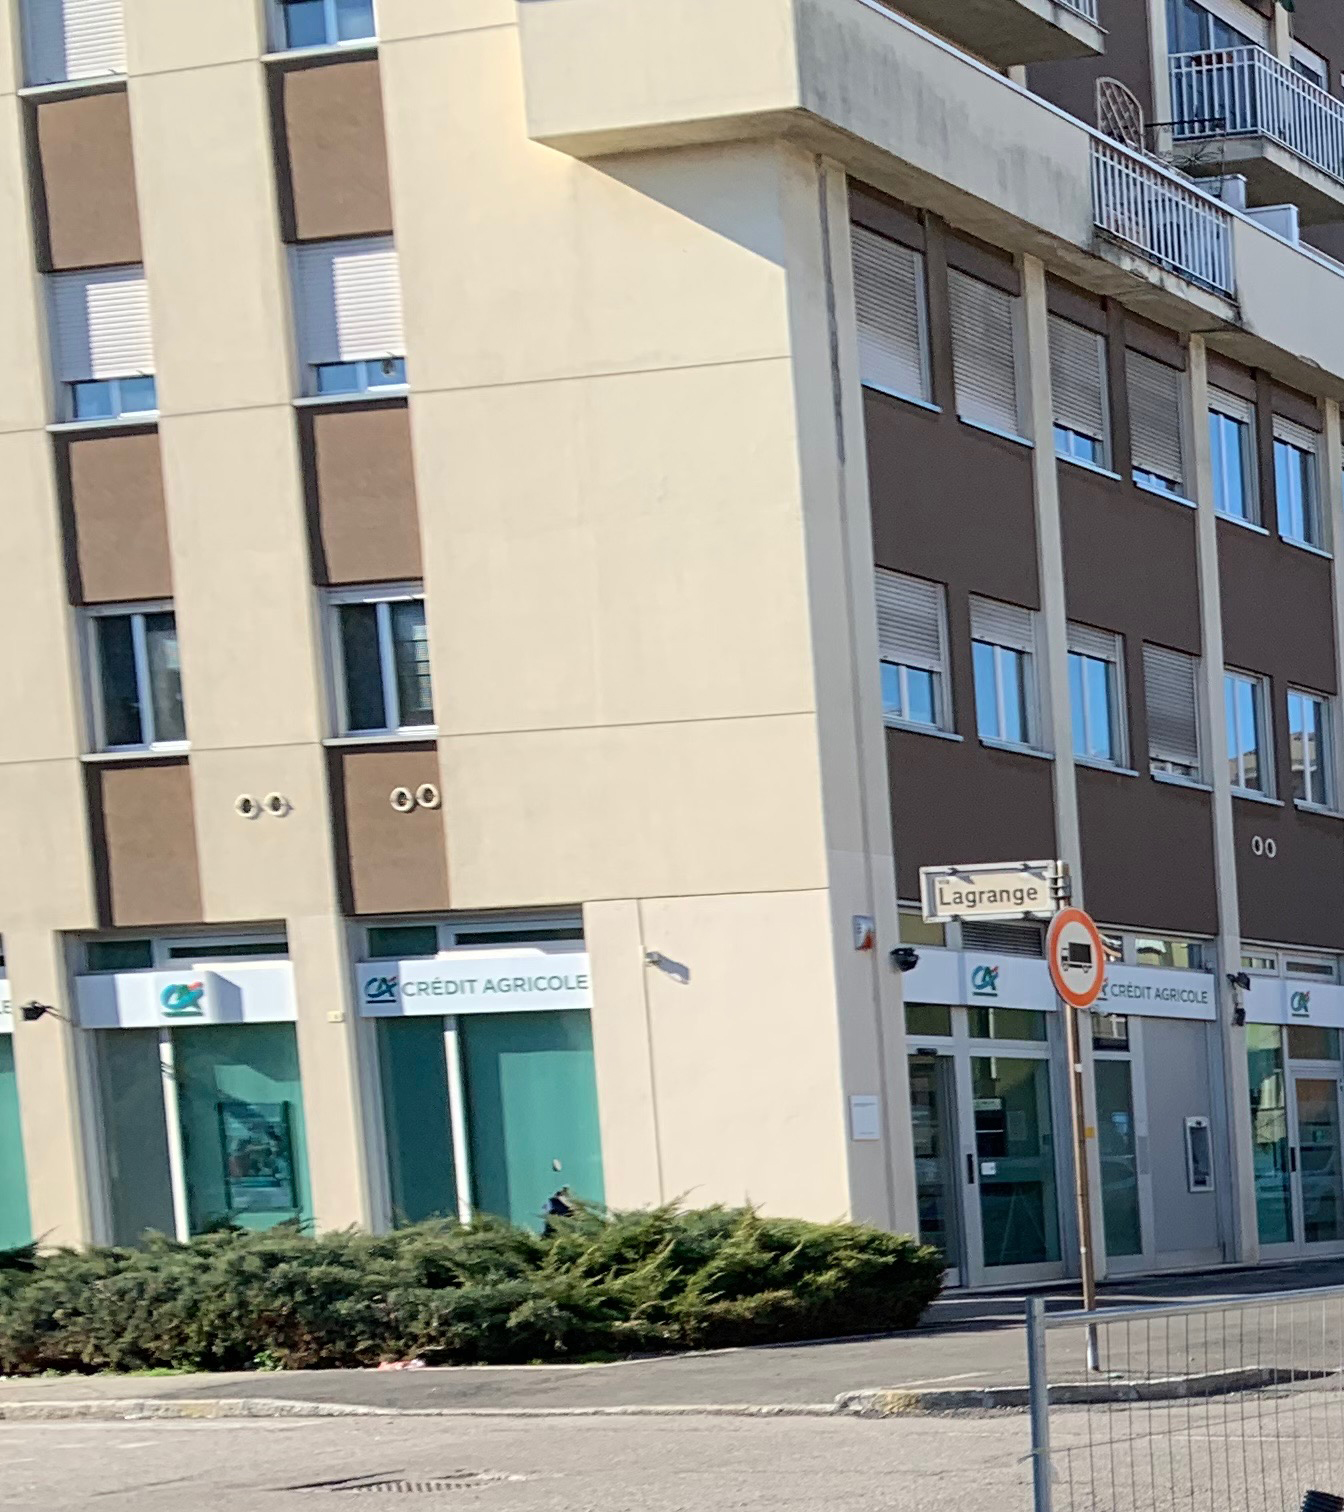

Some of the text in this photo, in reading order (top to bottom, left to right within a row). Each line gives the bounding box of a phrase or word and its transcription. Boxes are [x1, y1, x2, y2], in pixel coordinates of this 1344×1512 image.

[939, 886, 1038, 908] Lagrange
[402, 977, 477, 998] CRÉDIT
[482, 974, 589, 994] AGRICOLE
[1110, 981, 1208, 1004] CRÉDIT AGRICOLE
